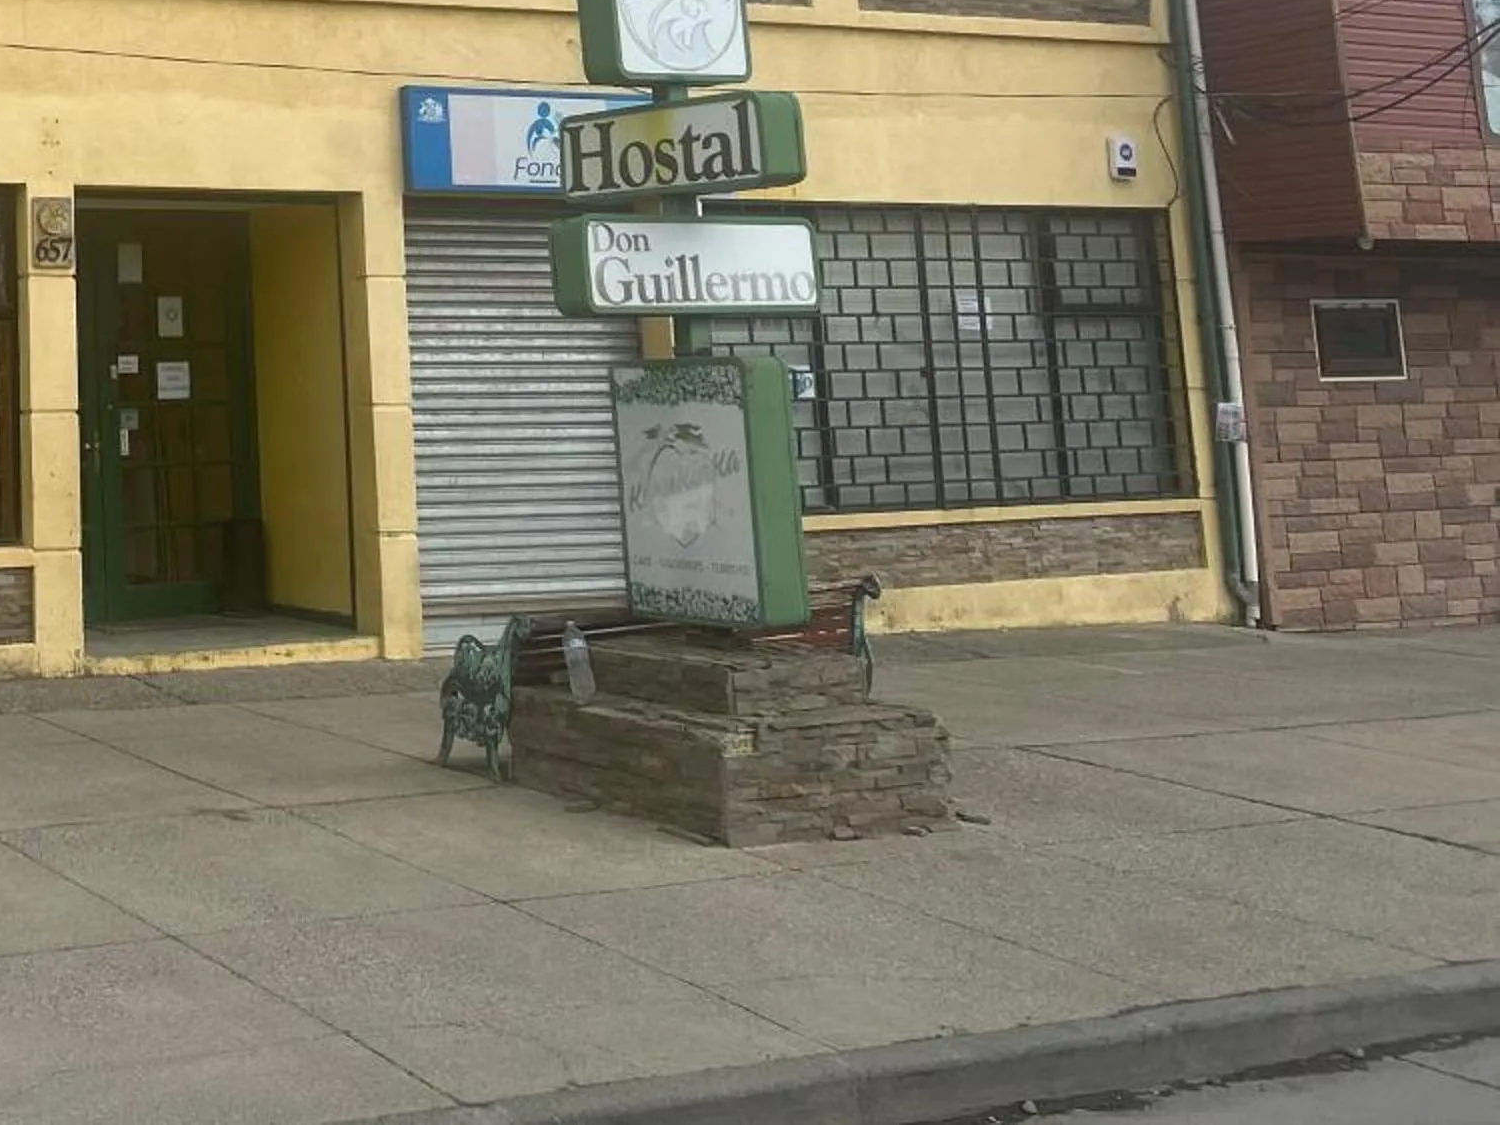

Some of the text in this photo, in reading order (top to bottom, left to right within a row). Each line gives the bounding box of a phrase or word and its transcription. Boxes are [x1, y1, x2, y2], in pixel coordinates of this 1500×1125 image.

[566, 97, 760, 194] Hostal
[35, 237, 72, 263] 657
[594, 223, 652, 254] Don
[598, 254, 814, 306] Guillermo
